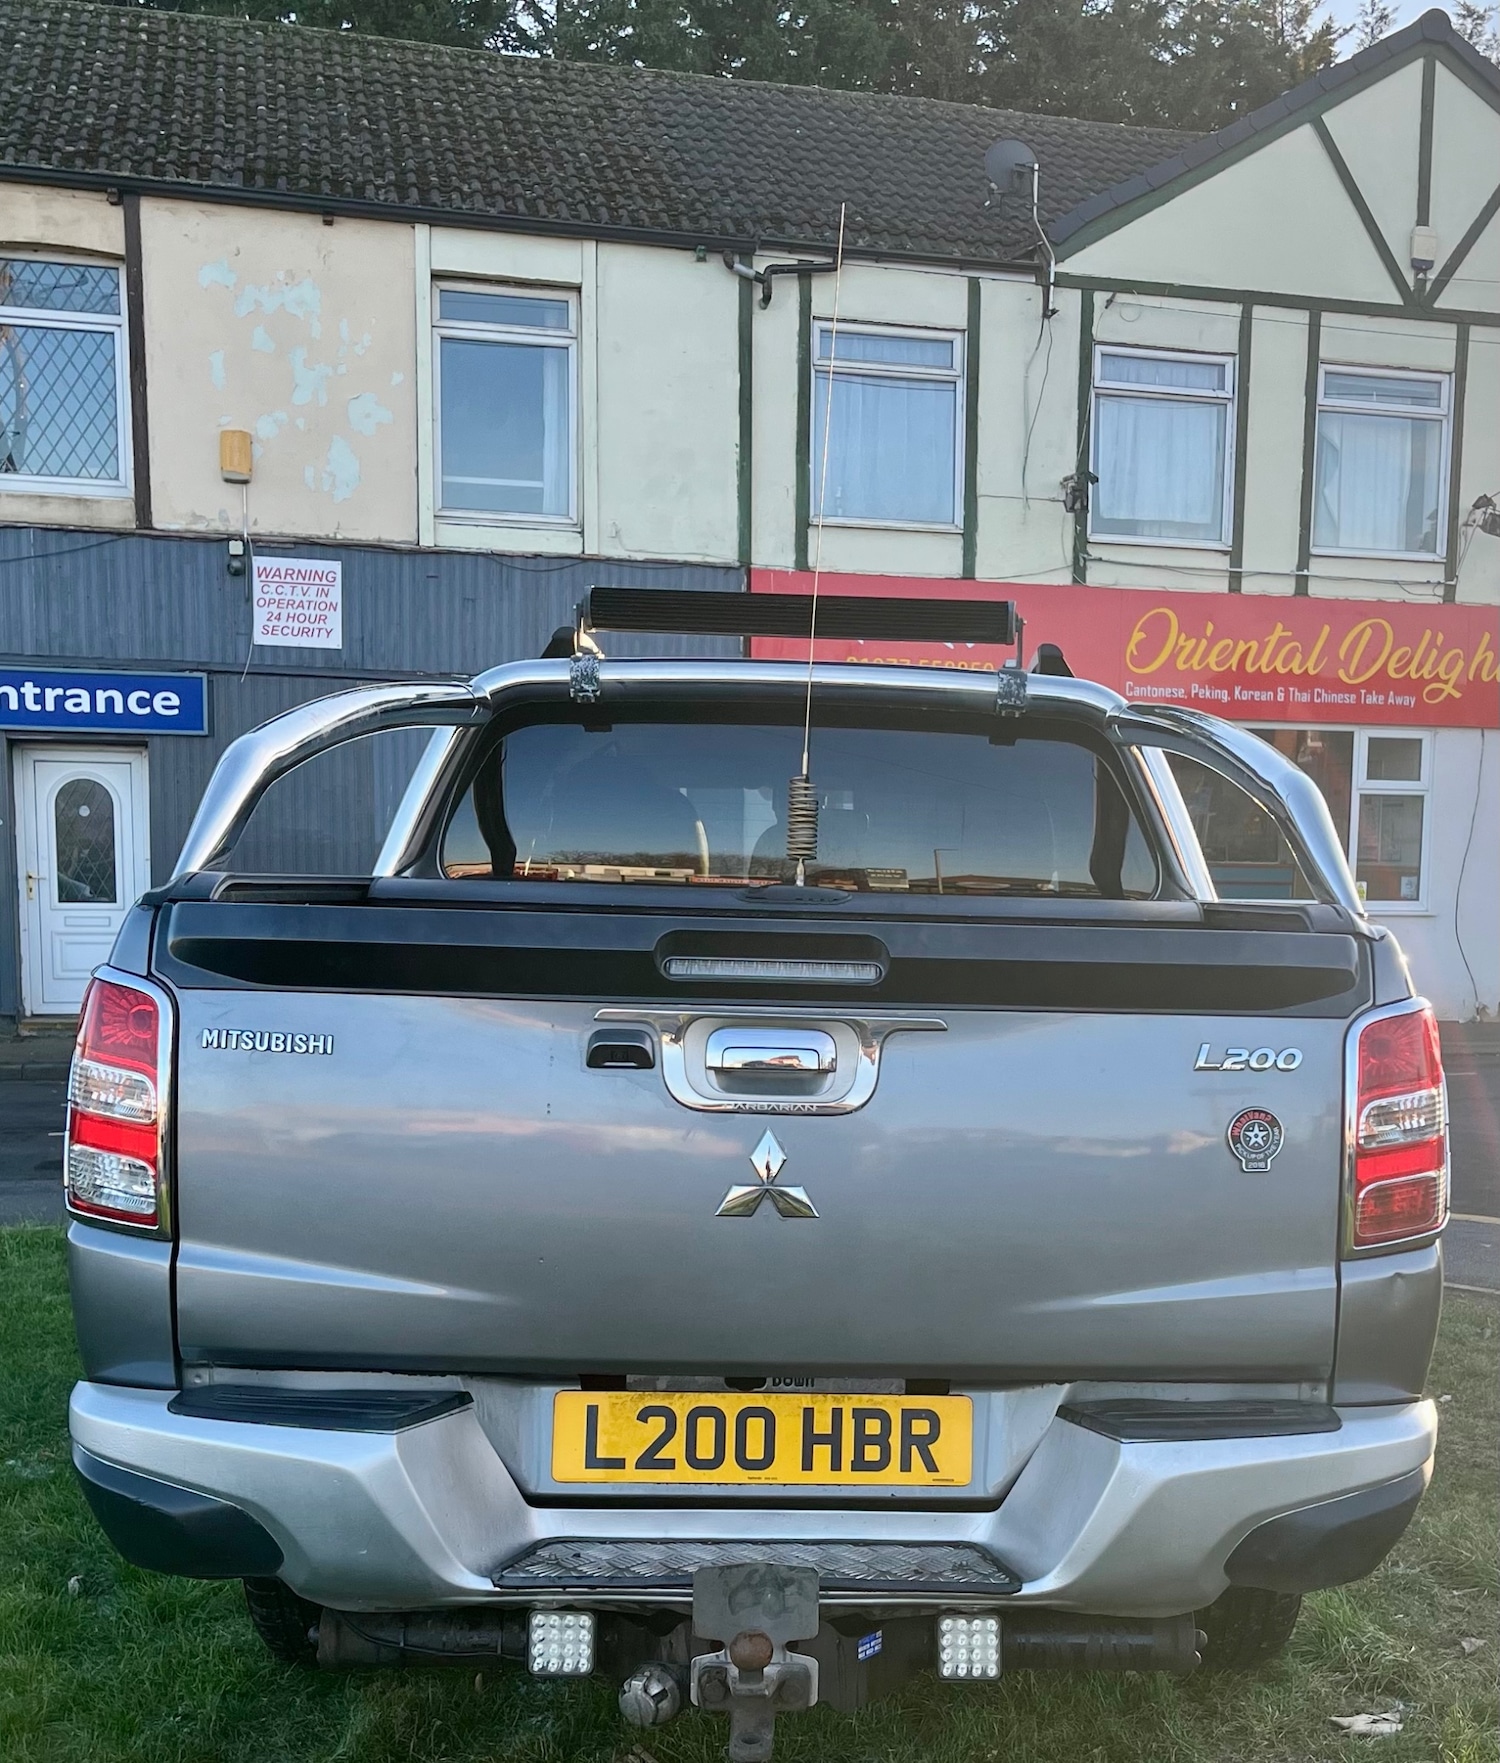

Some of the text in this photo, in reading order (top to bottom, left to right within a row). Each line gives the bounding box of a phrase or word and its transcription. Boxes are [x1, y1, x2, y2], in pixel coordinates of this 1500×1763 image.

[257, 566, 337, 583] WARNING
[261, 584, 330, 598] C.C.T.V. IN
[256, 597, 338, 612] OPERATION
[266, 611, 328, 625] 24 HOUR
[261, 624, 333, 639] SECURITY
[1126, 607, 1330, 676] Oriental
[1234, 686, 1273, 701] Korean
[1277, 687, 1285, 702] &
[1288, 687, 1311, 702] Thai
[1314, 688, 1356, 704] Chinese
[1360, 689, 1385, 705] Take
[1387, 691, 1416, 708] Away
[201, 1028, 334, 1055] MITSUBISHI
[1194, 1043, 1303, 1072] L200
[585, 1404, 941, 1473] L200 HBR
